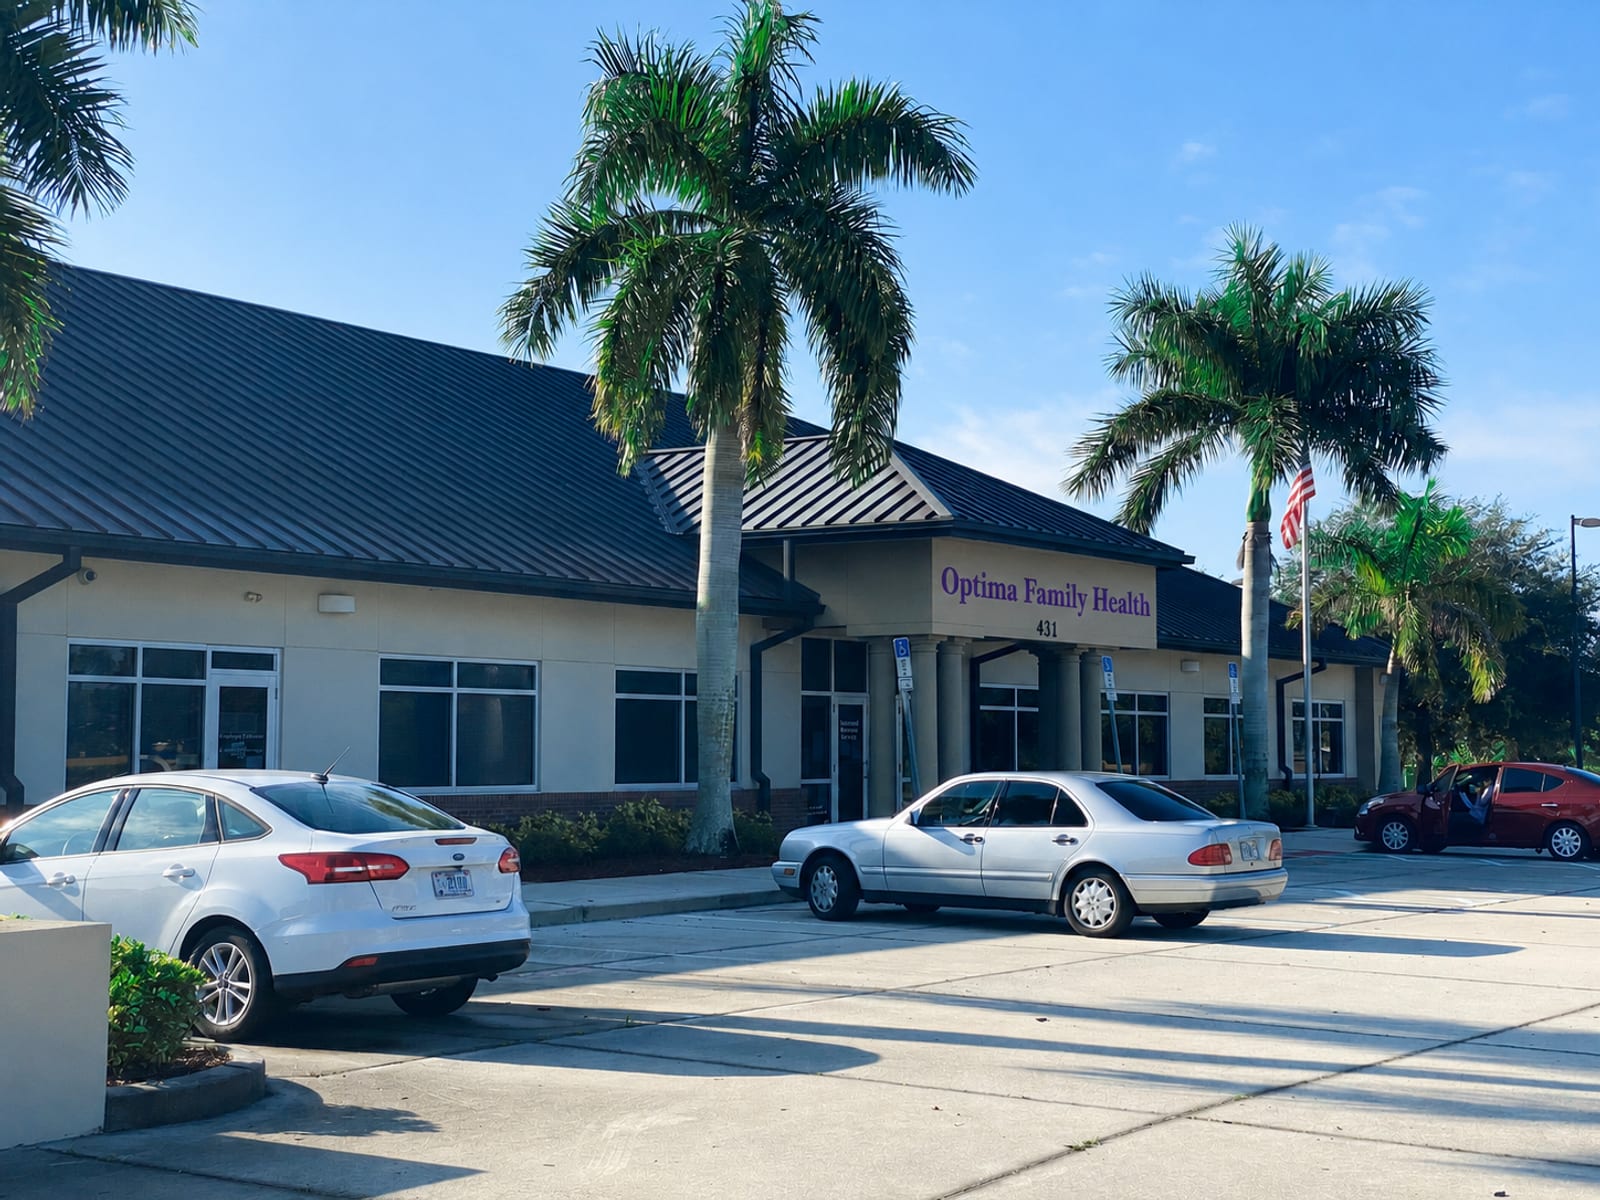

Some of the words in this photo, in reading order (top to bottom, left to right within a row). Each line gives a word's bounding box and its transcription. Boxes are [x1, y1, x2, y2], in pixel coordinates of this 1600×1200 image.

[941, 566, 1017, 604] Optima
[1024, 577, 1087, 616] Family
[1092, 586, 1151, 617] Health
[1036, 620, 1058, 638] 431
